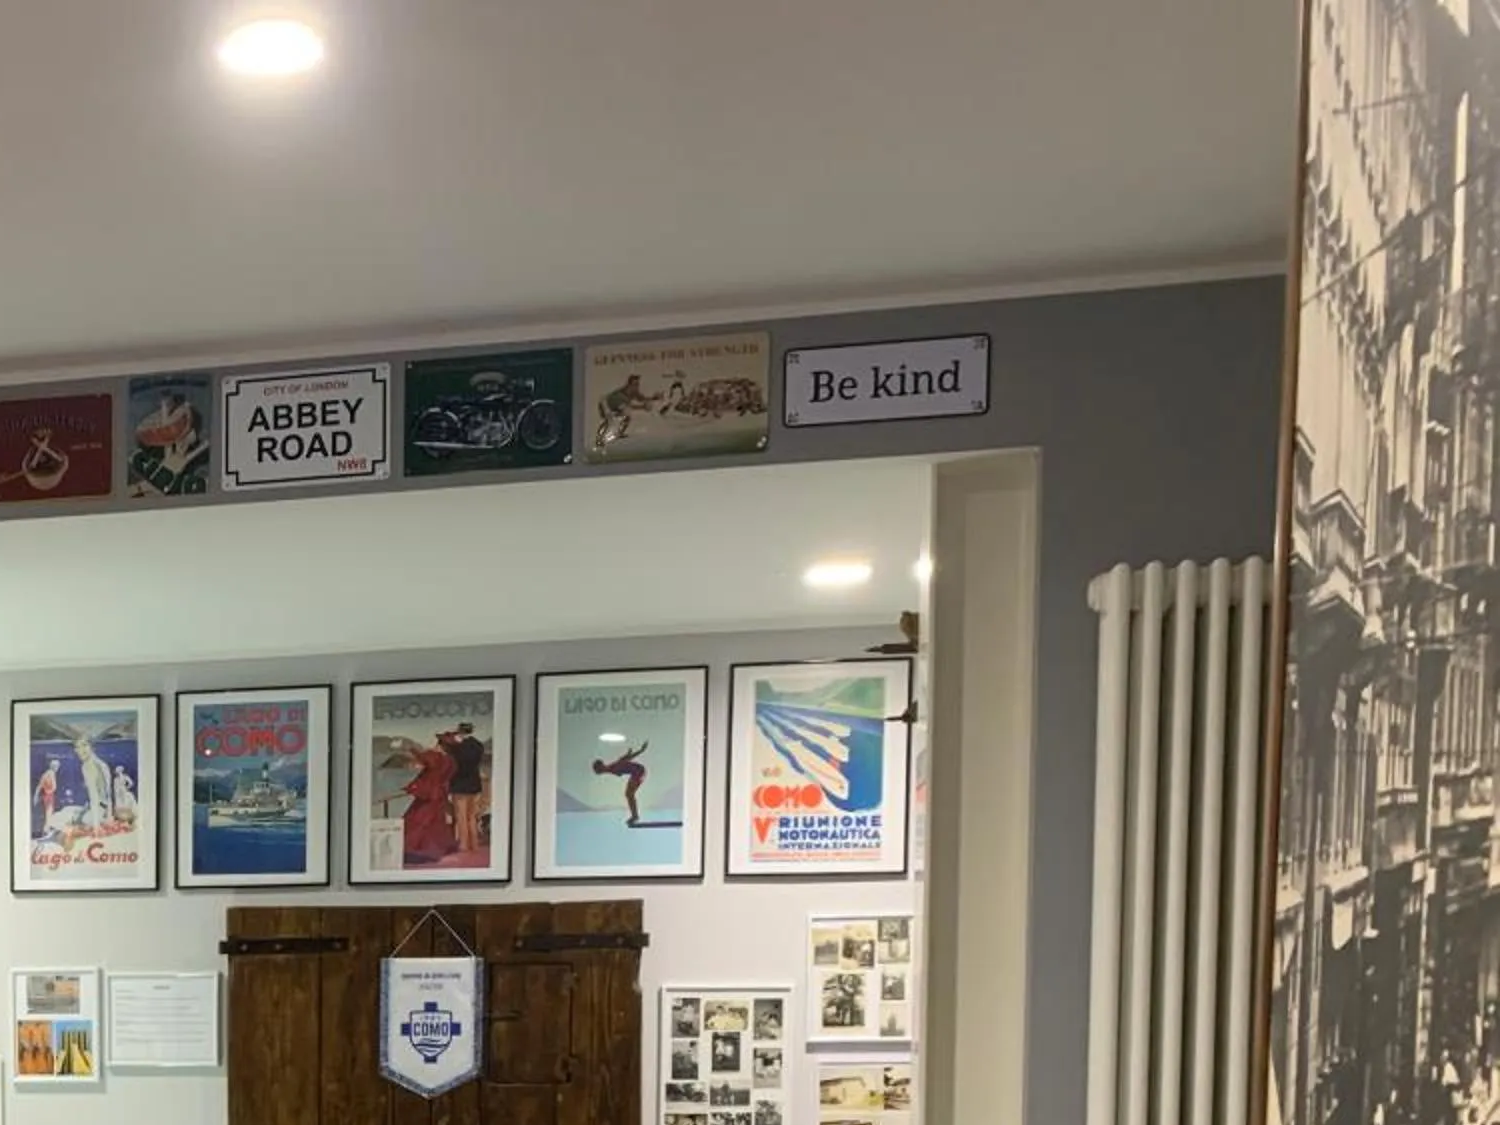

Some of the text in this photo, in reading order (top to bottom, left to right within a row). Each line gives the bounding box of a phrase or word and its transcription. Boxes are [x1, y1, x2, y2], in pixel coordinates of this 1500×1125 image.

[809, 359, 961, 403] Be kind
[248, 397, 364, 432] ABBEY
[257, 430, 353, 463] ROAD
[197, 725, 308, 759] COMO
[778, 814, 883, 829] RIUNIONE
[31, 844, 72, 870] Lago
[86, 841, 139, 864] Como
[412, 1022, 449, 1037] COMO
